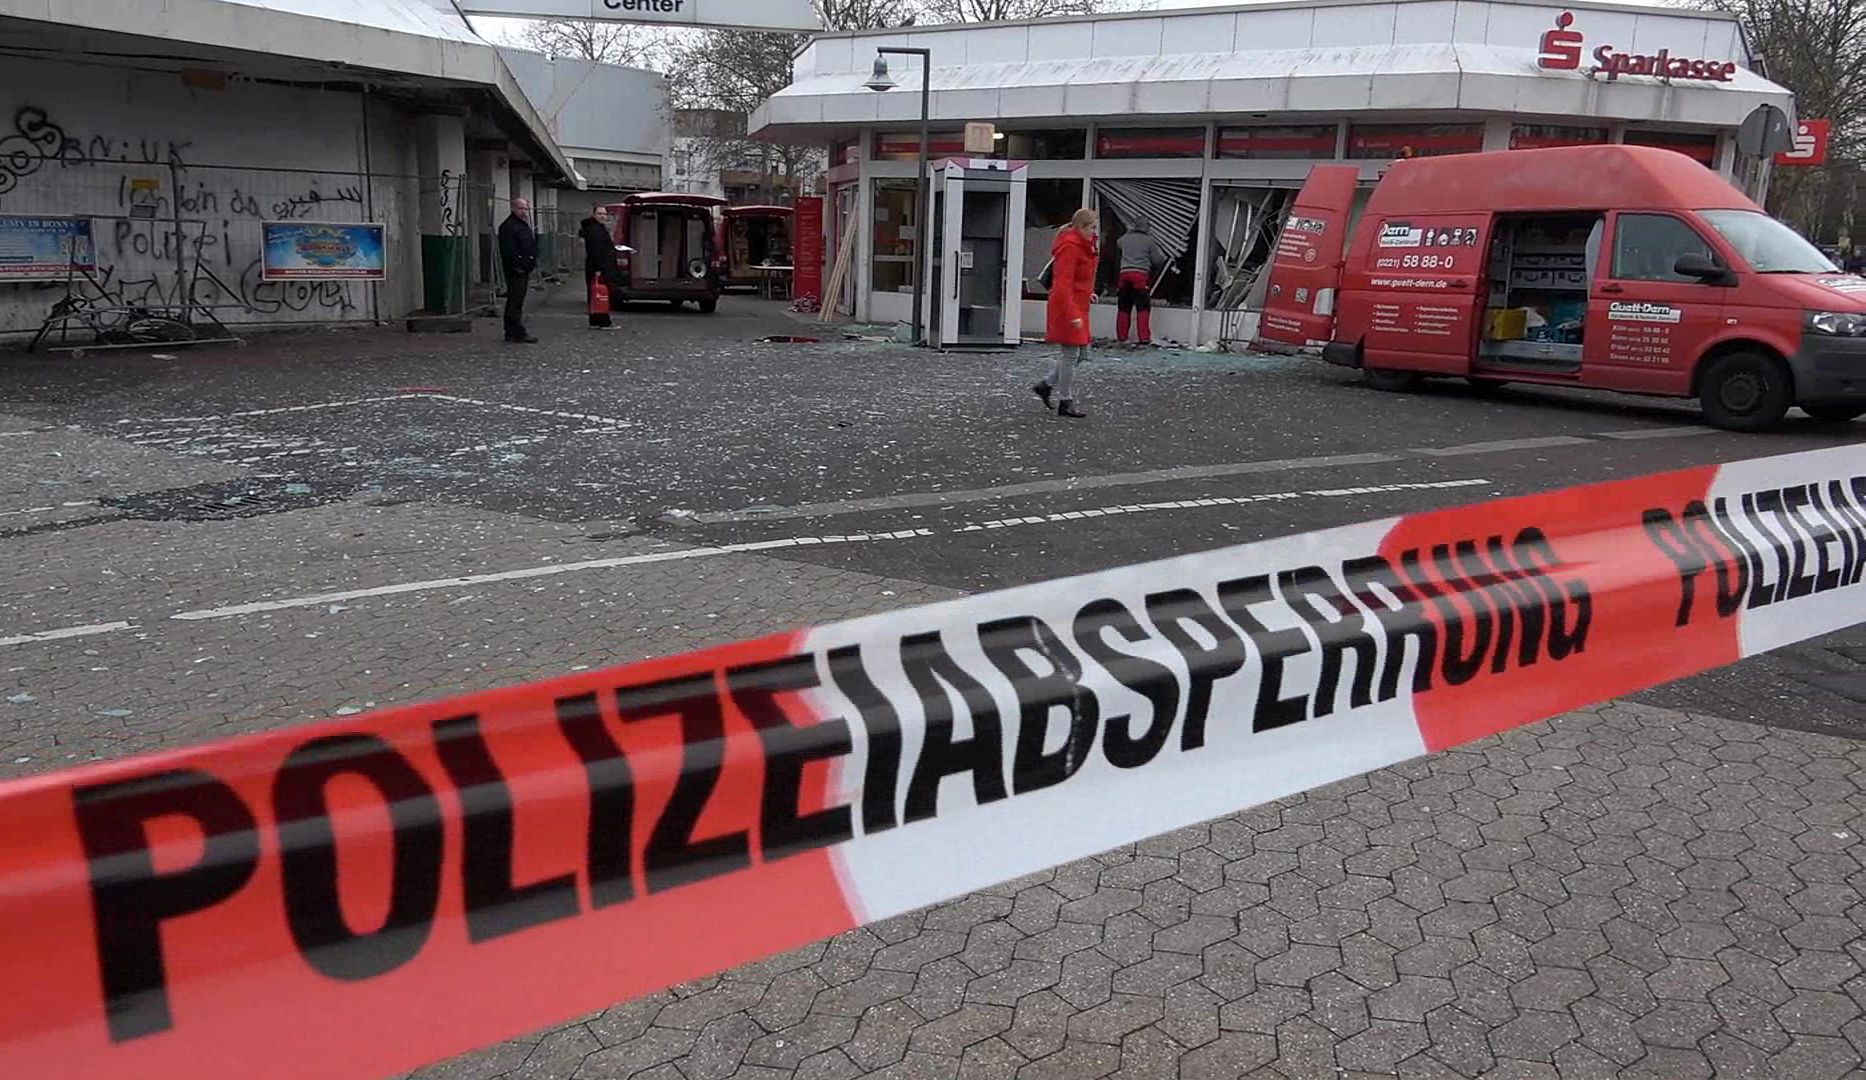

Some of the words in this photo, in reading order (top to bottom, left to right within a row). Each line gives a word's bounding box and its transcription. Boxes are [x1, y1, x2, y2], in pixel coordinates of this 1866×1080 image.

[1592, 45, 1736, 82] Sparkasse
[1376, 258, 1400, 268] (0221)
[1402, 255, 1419, 268] 58
[74, 526, 1592, 1044] POLIZEIABSPERRUNG
